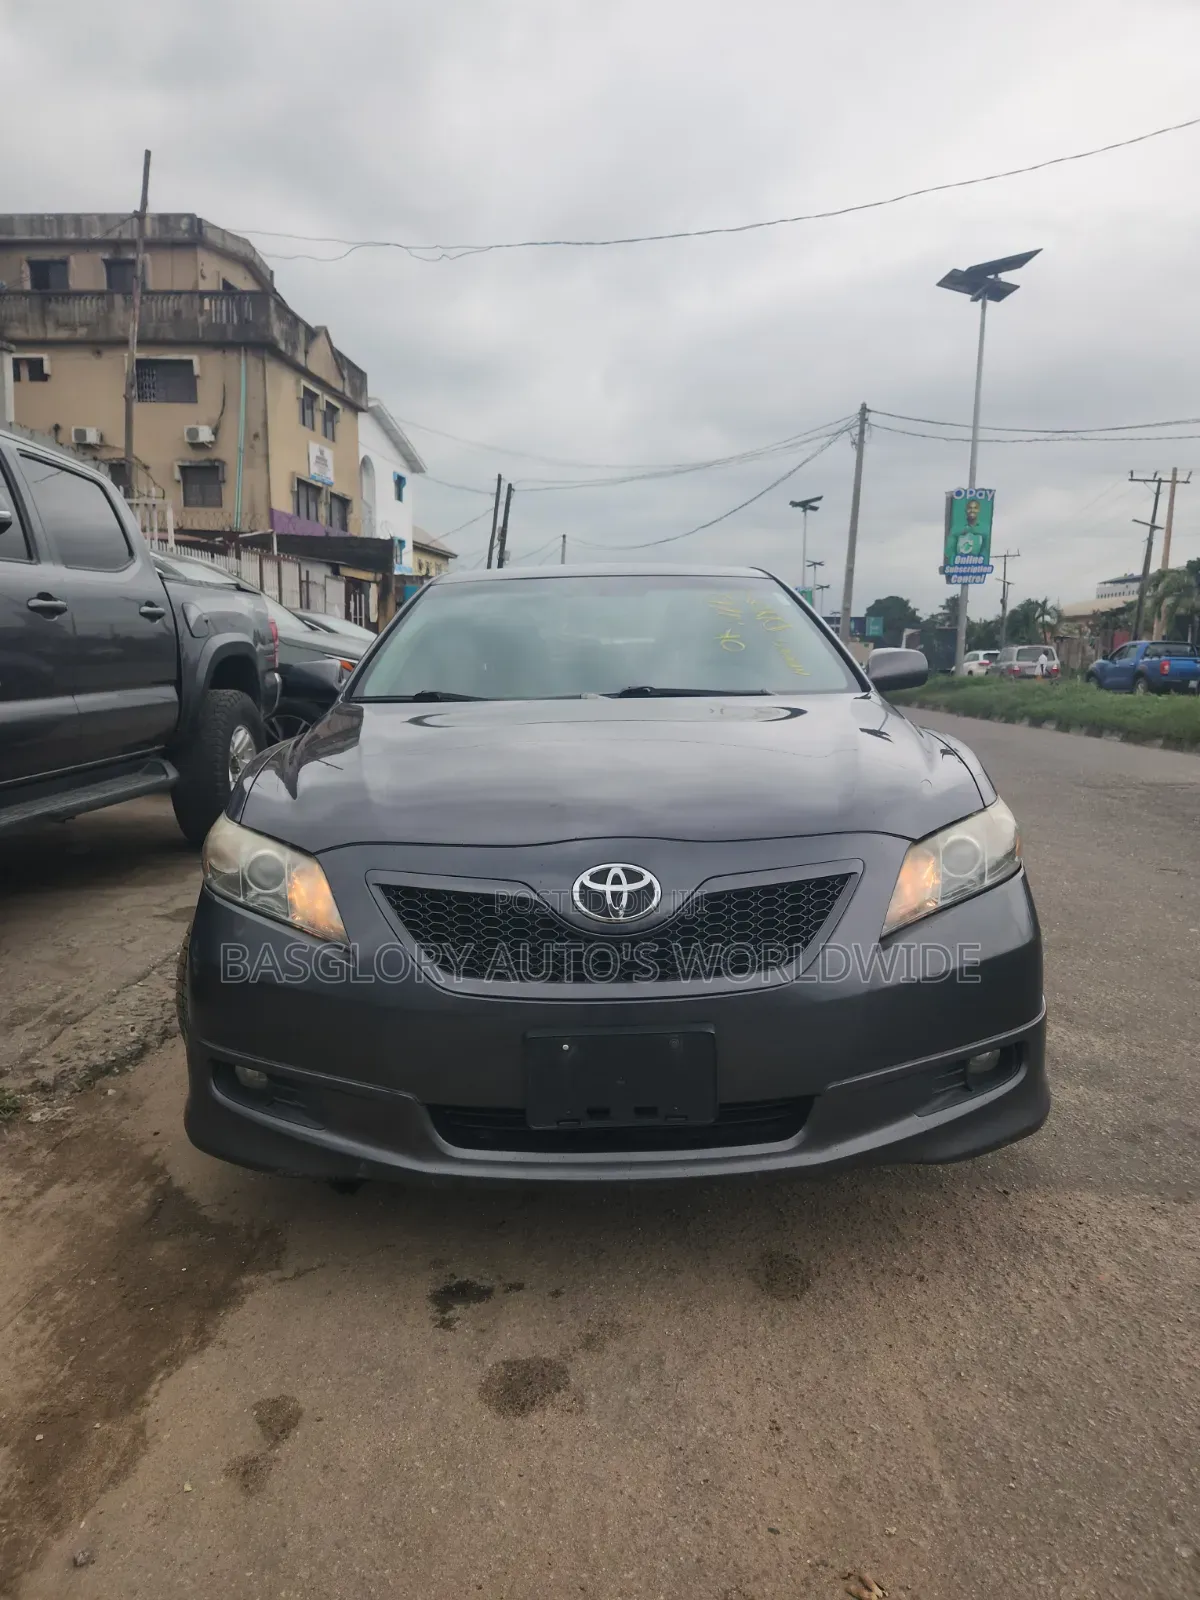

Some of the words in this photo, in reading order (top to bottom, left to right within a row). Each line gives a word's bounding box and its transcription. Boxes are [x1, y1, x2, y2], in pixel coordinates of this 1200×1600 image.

[953, 488, 995, 501] OPay
[954, 555, 984, 564] Online
[951, 574, 985, 583] Control
